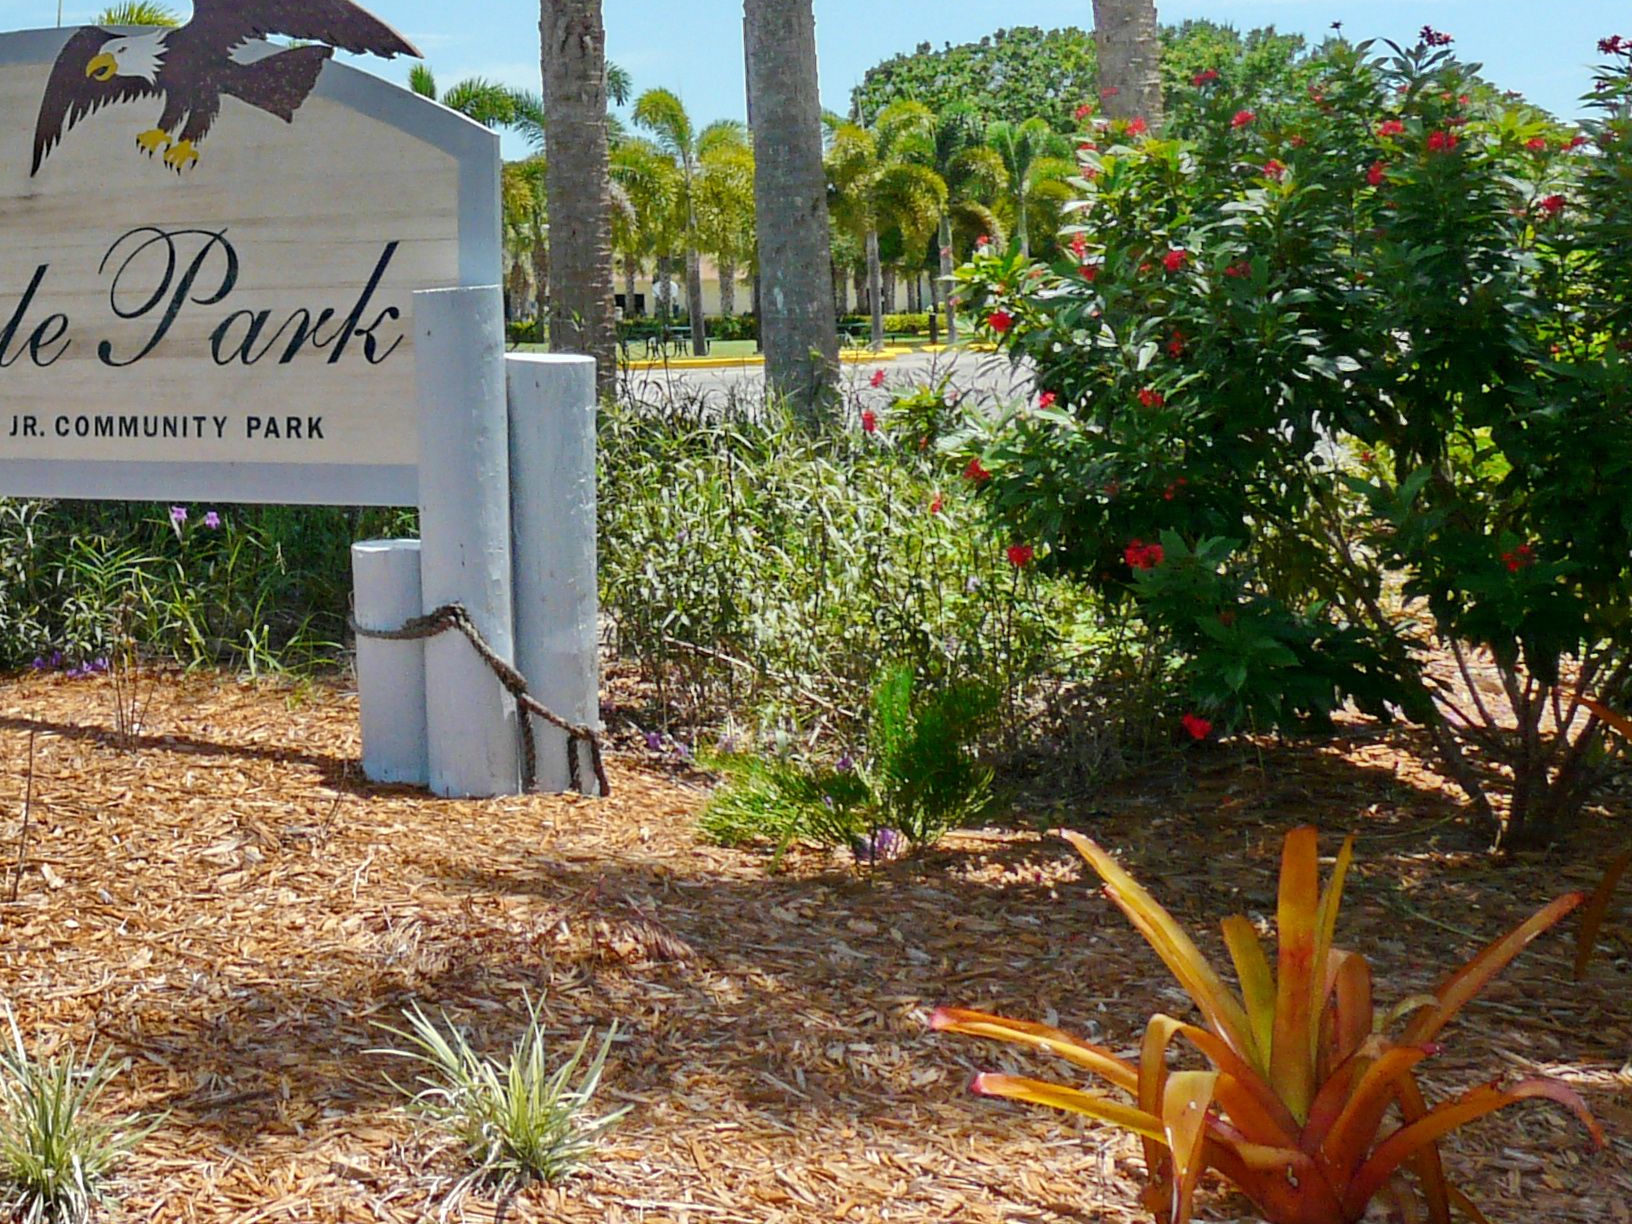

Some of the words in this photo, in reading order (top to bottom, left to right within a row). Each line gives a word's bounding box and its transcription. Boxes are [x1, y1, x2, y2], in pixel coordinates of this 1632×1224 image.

[97, 226, 404, 367] Park
[9, 415, 47, 438] JR.
[55, 415, 228, 439] COMMUNITY
[246, 416, 325, 440] PARK
